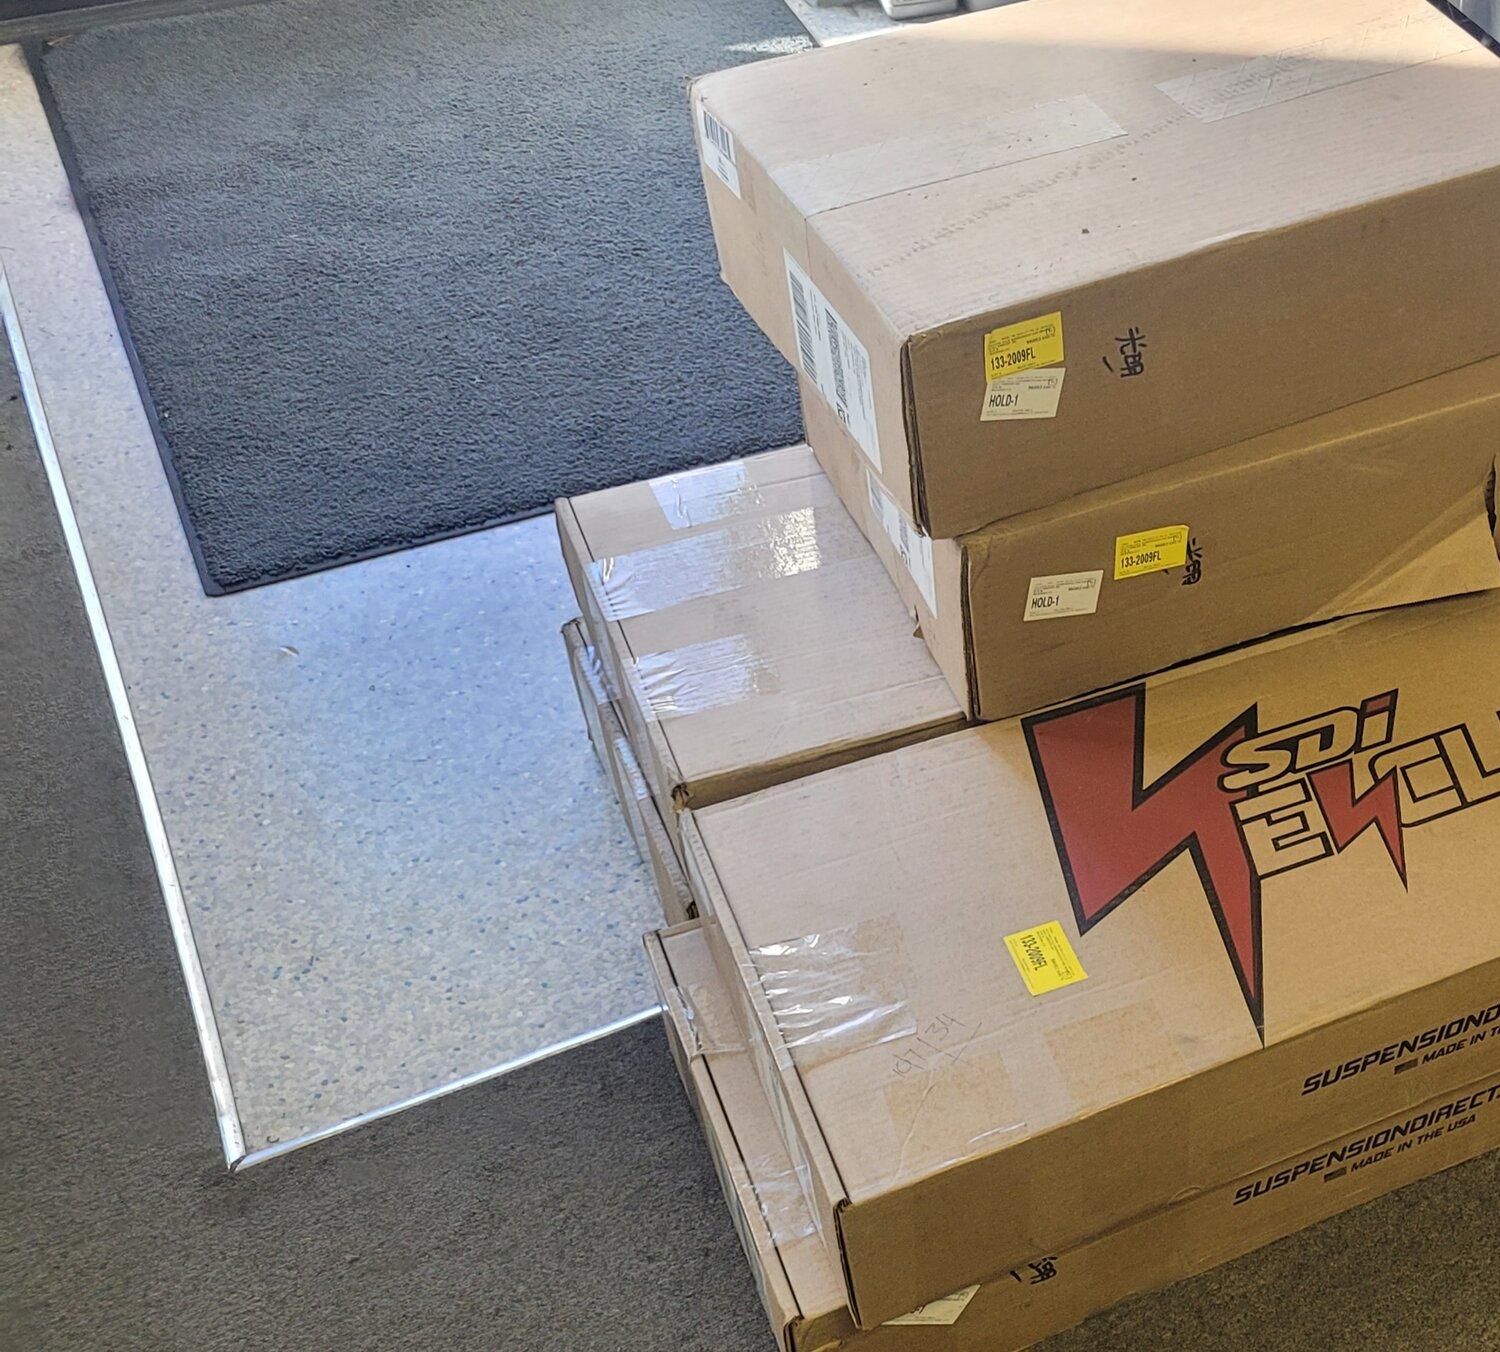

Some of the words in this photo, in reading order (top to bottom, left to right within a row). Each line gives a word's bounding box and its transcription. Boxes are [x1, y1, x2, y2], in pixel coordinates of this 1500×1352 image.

[991, 346, 1037, 371] 133-2009FL
[988, 394, 1019, 408] HOLD-1
[1121, 550, 1162, 569] 133-2009FL
[1031, 595, 1060, 609] HOLD-1
[1421, 1041, 1466, 1066] MADE
[1469, 1034, 1487, 1048] IN
[1350, 1148, 1394, 1173] MADE
[1396, 1139, 1414, 1153] IN
[1416, 1127, 1444, 1145] THE
[1446, 1113, 1477, 1133] USA
